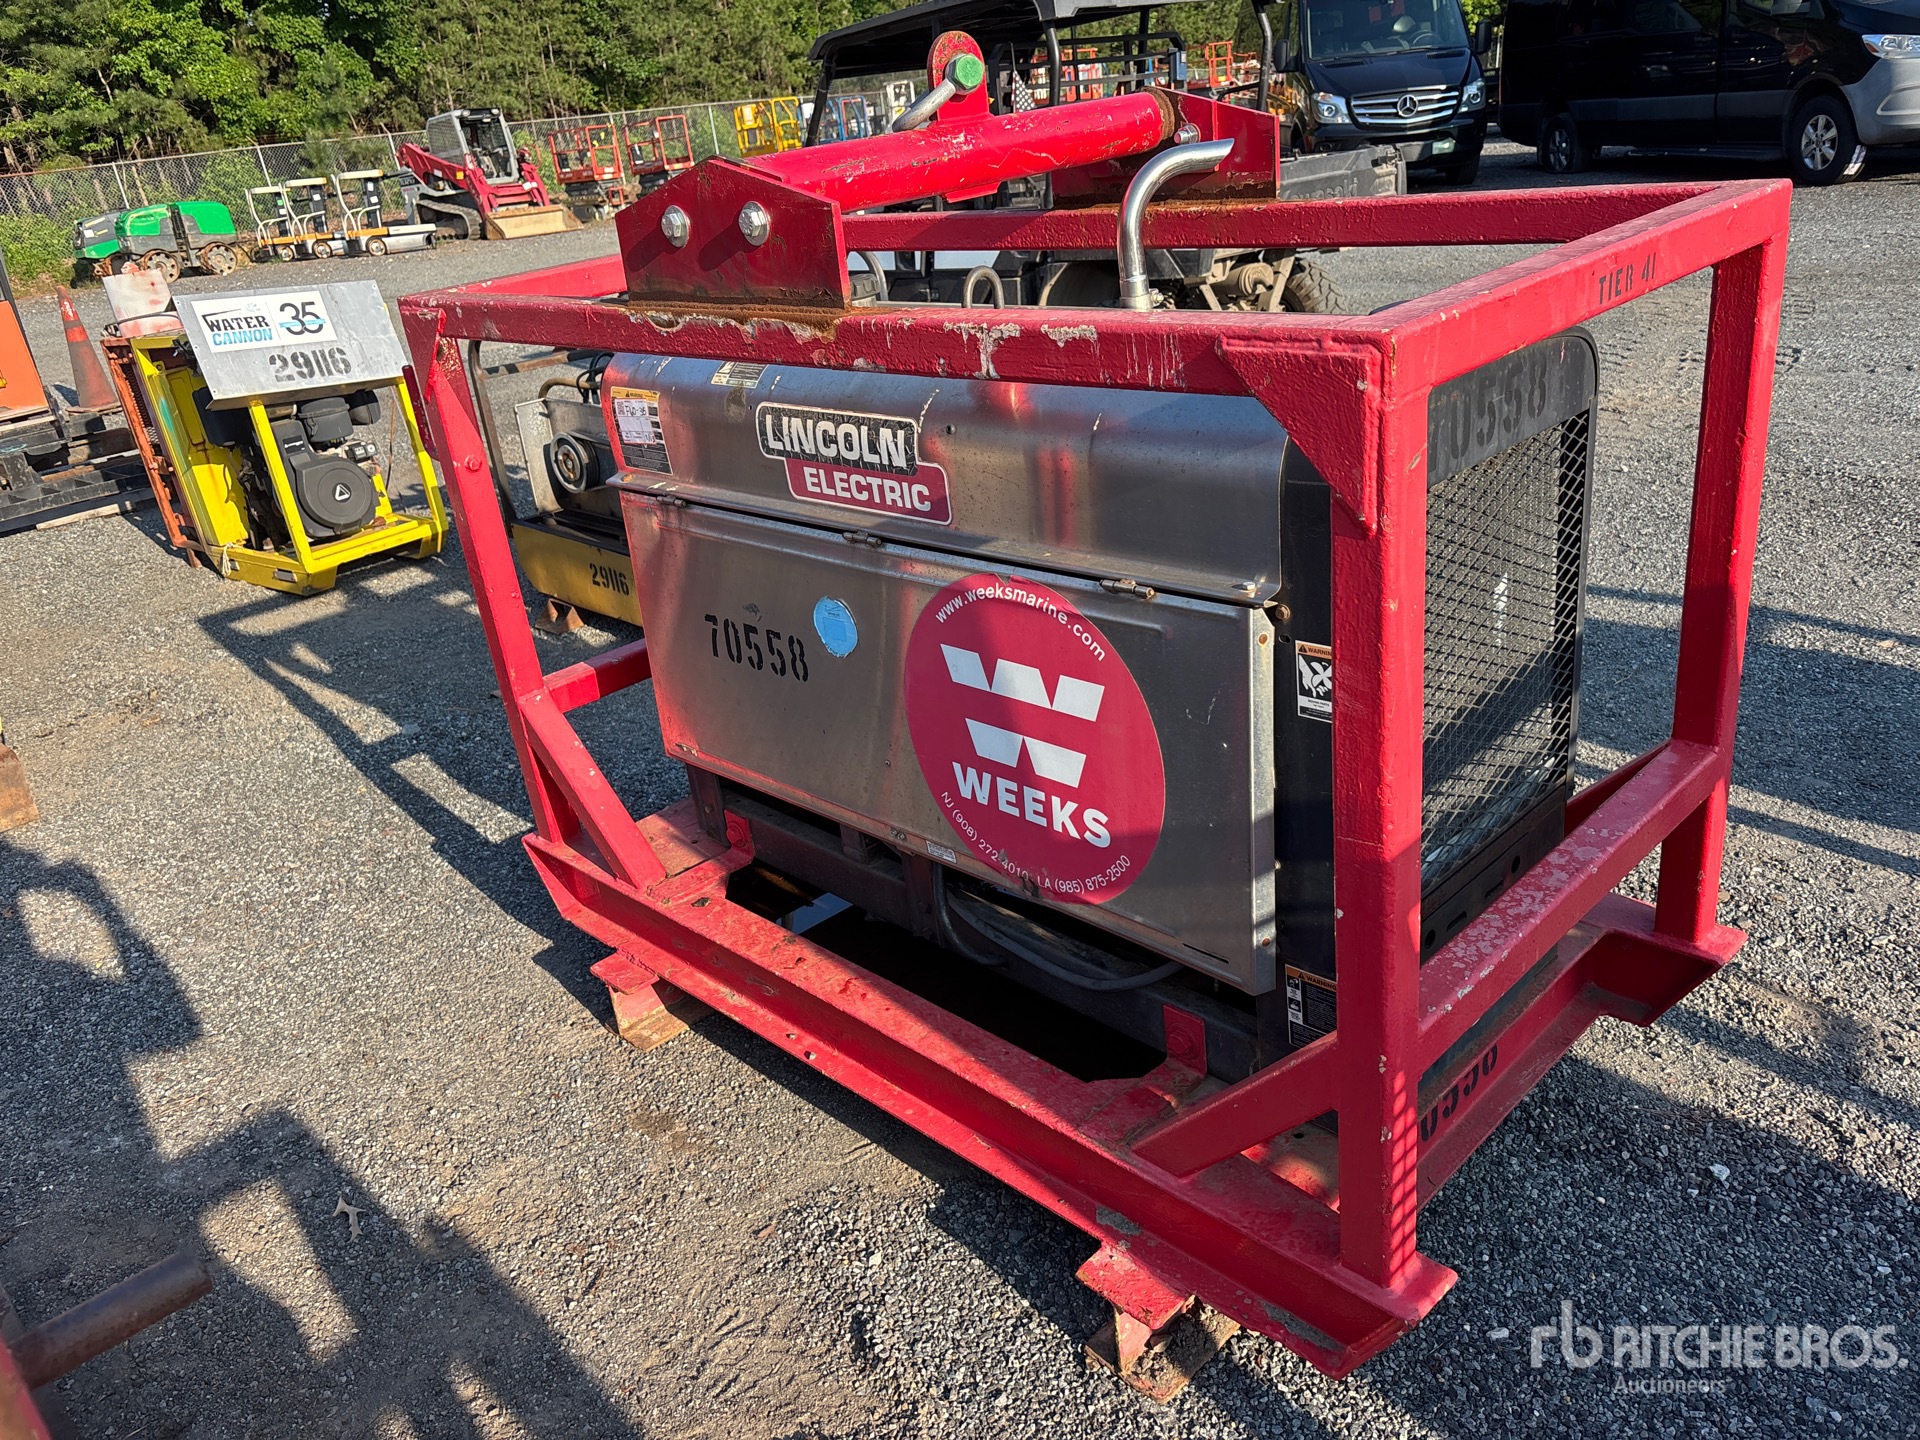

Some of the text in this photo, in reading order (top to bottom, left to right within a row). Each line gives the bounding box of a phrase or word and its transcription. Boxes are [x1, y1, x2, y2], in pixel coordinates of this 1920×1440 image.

[1599, 264, 1634, 305] TIER
[202, 314, 270, 333] WATER
[212, 328, 273, 346] CANNON
[279, 301, 325, 336] 35
[268, 347, 352, 383] 29116
[765, 414, 908, 468] LINCOLN
[803, 466, 931, 512] ELECTRIC
[589, 562, 630, 596] 29116
[935, 582, 1106, 662] www.weeksmarine.com
[704, 613, 809, 683] 70558
[1308, 647, 1332, 657] WARNIN
[952, 761, 1111, 848] WEEKS
[941, 791, 953, 808] NJ
[952, 809, 978, 842] (908)
[1037, 876, 1053, 890] LA
[1054, 878, 1085, 894] (985)
[1086, 854, 1131, 890] 875-2500
[1307, 975, 1337, 991] WARNING
